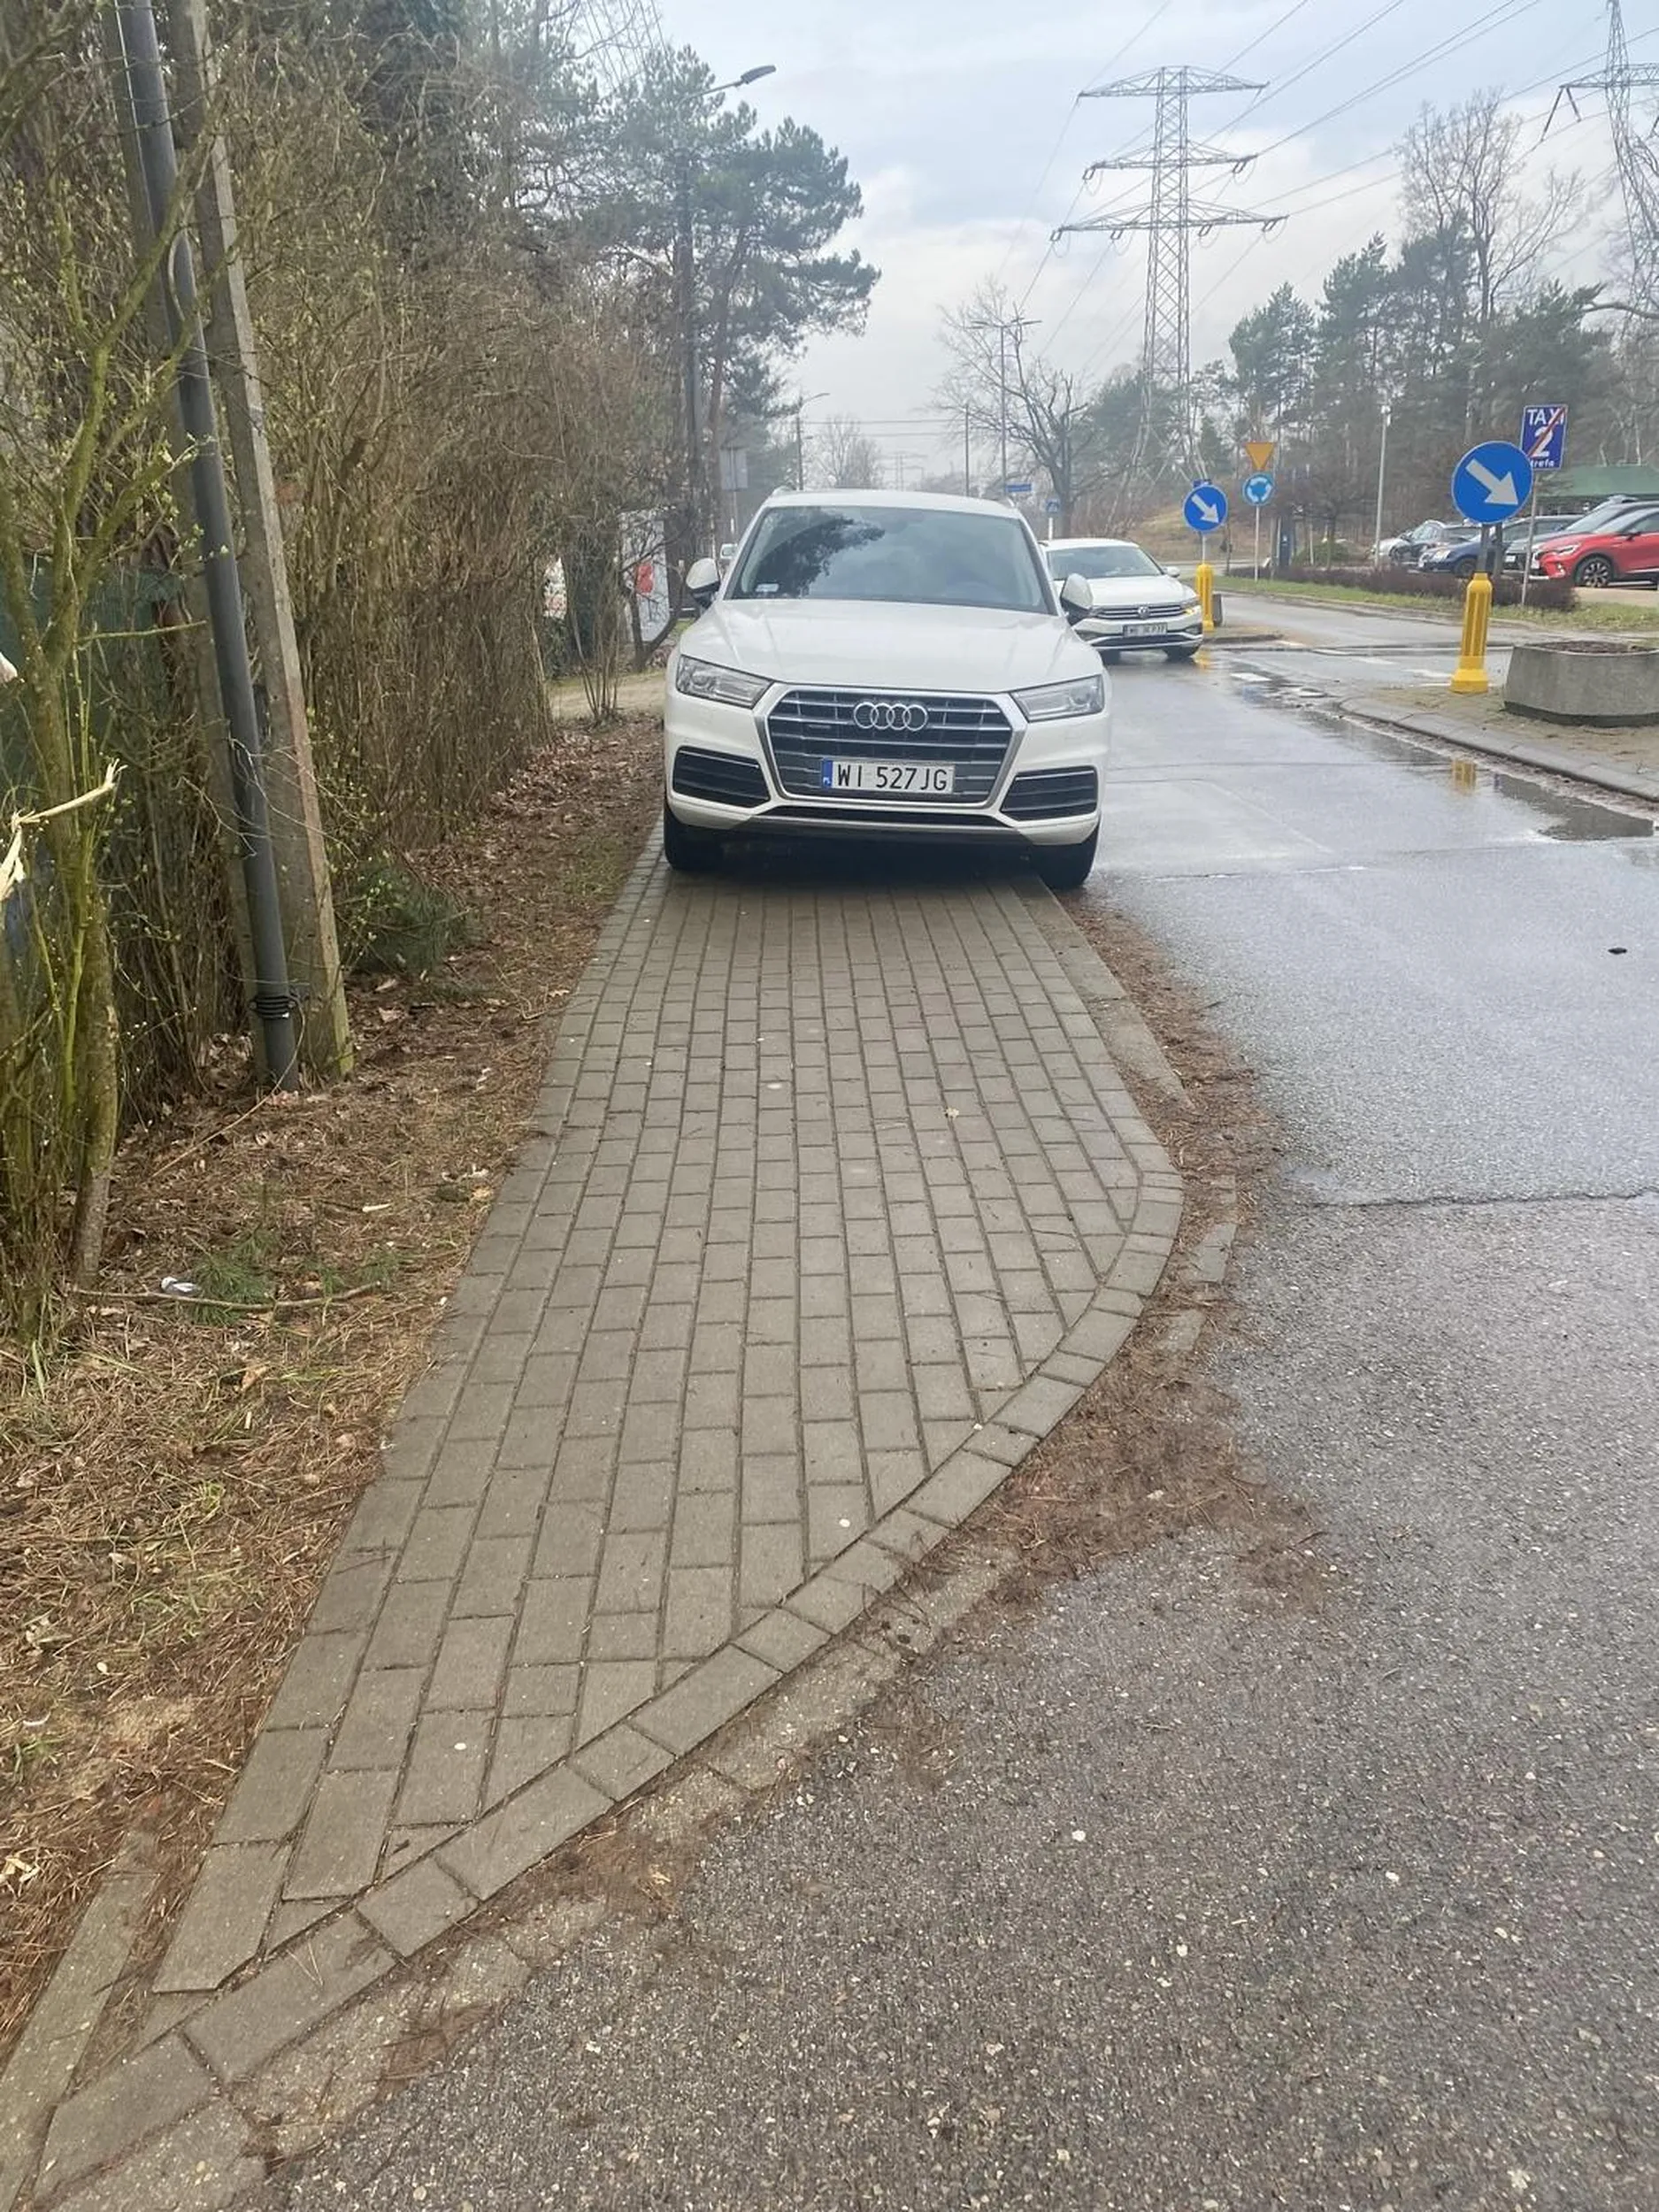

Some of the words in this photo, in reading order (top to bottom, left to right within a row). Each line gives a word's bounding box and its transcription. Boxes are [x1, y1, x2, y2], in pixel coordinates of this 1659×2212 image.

[1527, 408, 1564, 426] TAXI
[1532, 426, 1553, 457] 2
[1529, 458, 1555, 468] trefa
[838, 764, 863, 787] WI
[876, 766, 949, 790] 527JG
